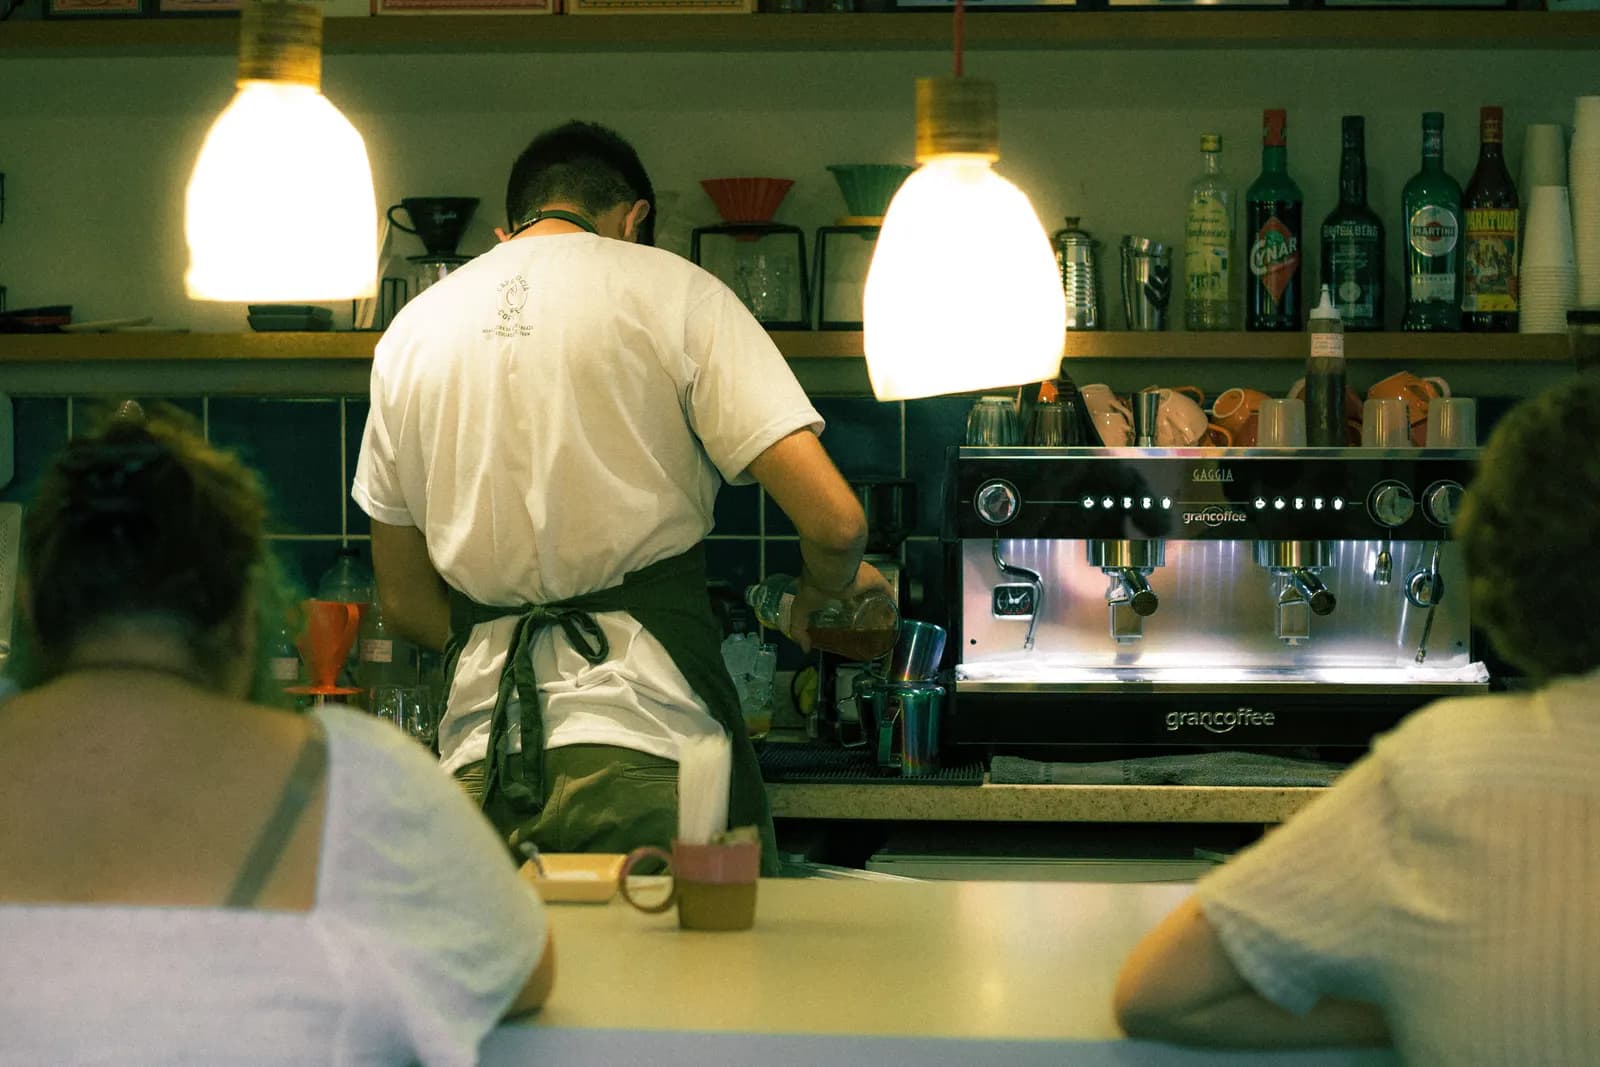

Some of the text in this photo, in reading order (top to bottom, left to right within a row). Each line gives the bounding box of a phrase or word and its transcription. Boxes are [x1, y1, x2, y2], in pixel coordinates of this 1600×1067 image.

[1415, 226, 1456, 237] MARTINI
[1250, 236, 1297, 276] CYNAR
[1192, 468, 1234, 481] GAGGIA
[1183, 510, 1247, 525] grancoffee
[1166, 707, 1276, 731] grancoffee
